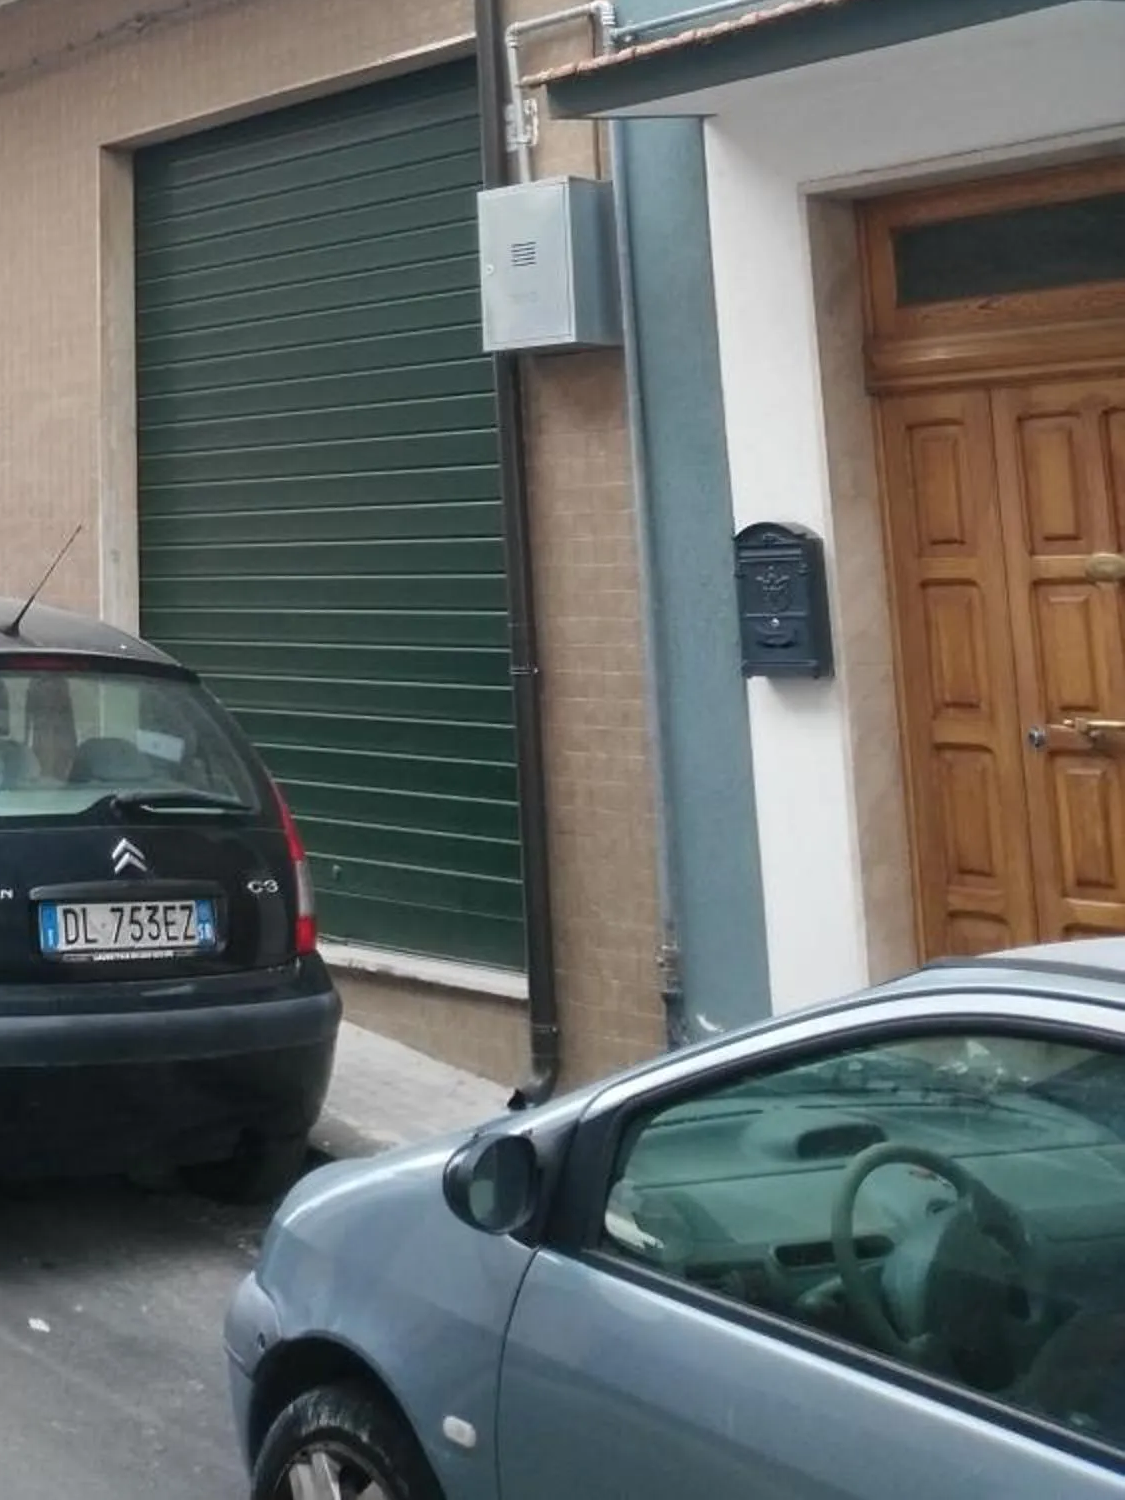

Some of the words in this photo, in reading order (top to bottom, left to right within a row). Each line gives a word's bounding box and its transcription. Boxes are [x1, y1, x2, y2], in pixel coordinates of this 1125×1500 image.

[246, 879, 279, 893] C3
[62, 907, 98, 945] DL
[109, 904, 198, 944] 753EZ
